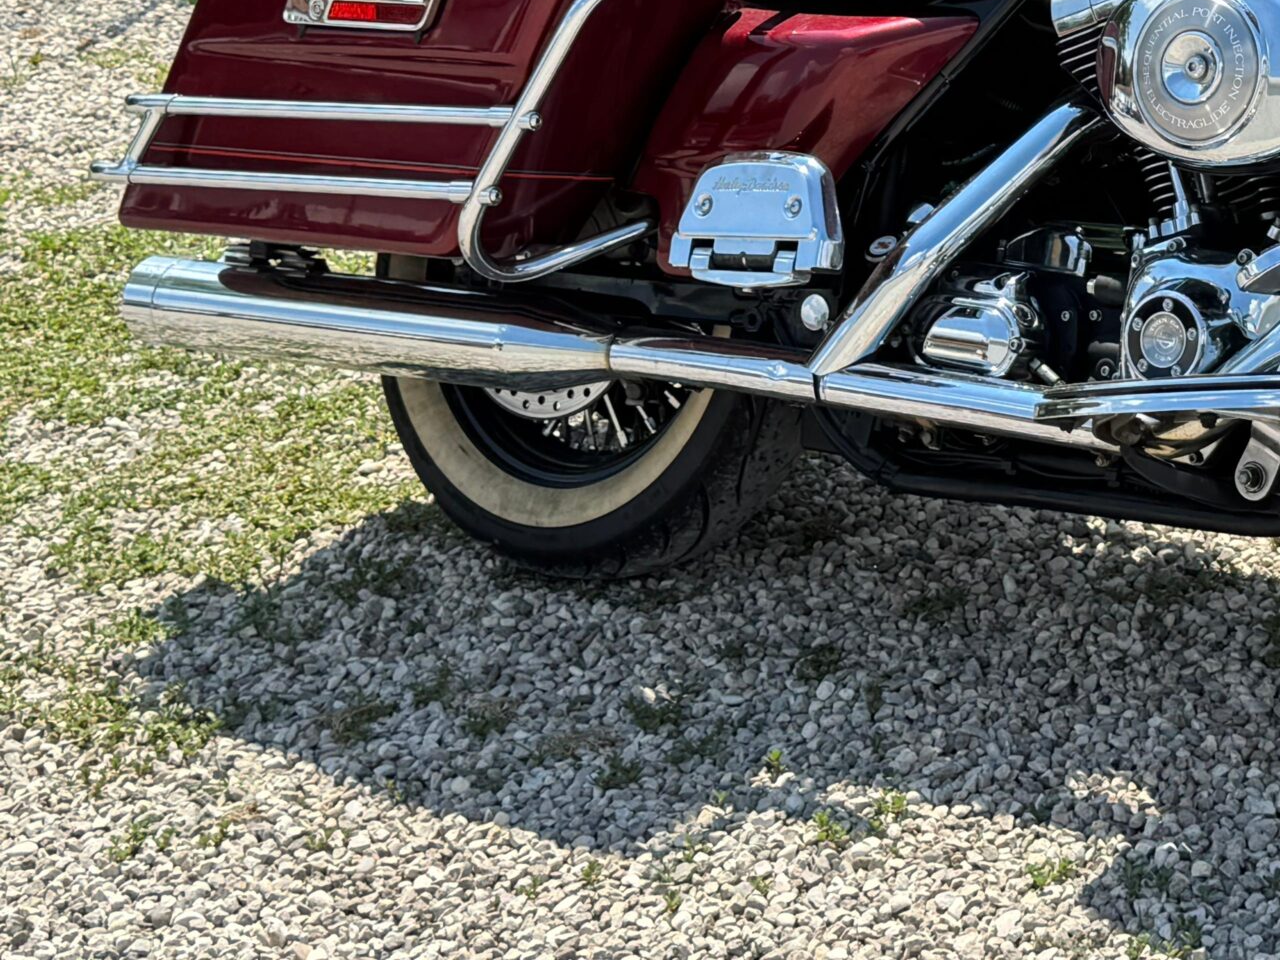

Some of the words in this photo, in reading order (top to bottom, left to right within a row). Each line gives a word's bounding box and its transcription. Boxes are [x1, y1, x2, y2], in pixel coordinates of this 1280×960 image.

[1143, 9, 1189, 86] SEQUENTIAL
[1192, 6, 1224, 25] PORT
[1224, 24, 1245, 100] INJECTION
